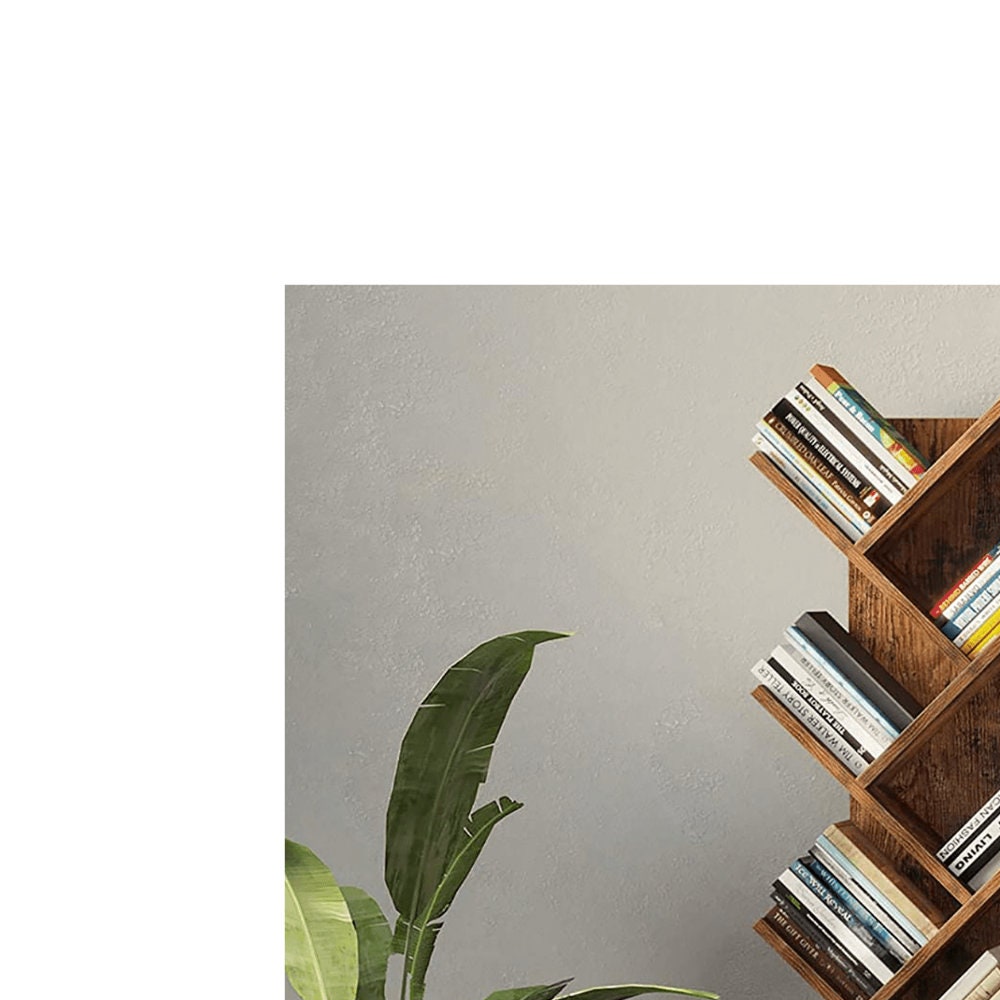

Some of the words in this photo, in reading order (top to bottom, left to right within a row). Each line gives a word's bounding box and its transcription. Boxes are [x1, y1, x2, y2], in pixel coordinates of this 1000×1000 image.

[784, 412, 802, 429] POWER
[796, 425, 819, 446] QUALITY
[817, 445, 845, 472] ELECTRICAL
[839, 467, 862, 489] SYSTEMS
[816, 463, 834, 481] LEAF
[757, 665, 785, 693] TELLER
[790, 679, 810, 699] BOOK
[820, 677, 843, 700] STORY
[782, 690, 810, 717] STORY
[841, 698, 869, 725] WALKER
[806, 714, 840, 748] WALKER
[831, 720, 847, 735] THE
[867, 723, 881, 737] TIM
[837, 744, 854, 762] TIM
[939, 817, 981, 859] FASHION
[954, 833, 993, 871] LIVING
[772, 911, 789, 928] THE
